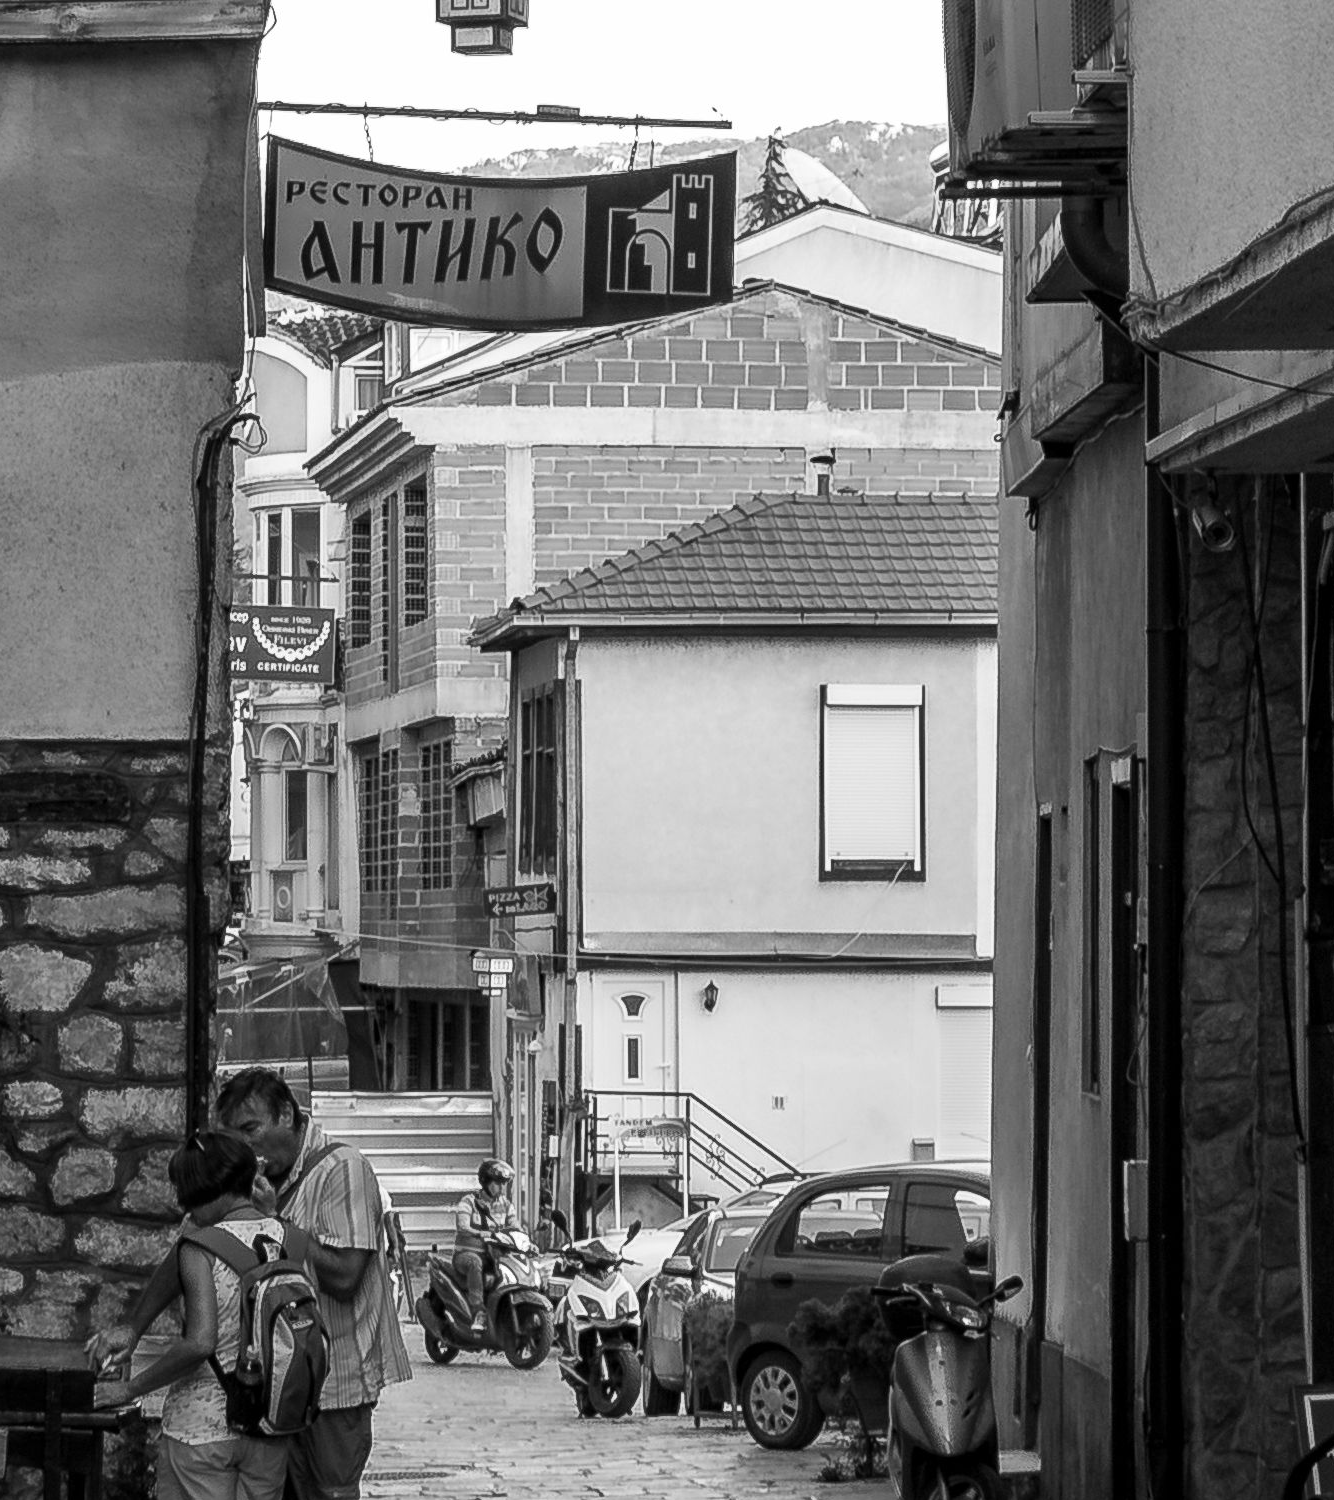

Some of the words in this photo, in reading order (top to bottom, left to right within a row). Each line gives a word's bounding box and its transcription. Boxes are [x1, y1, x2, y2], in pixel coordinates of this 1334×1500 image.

[285, 179, 473, 213] РЕСТОРАН
[299, 205, 564, 286] АНТИКО
[257, 661, 320, 674] CERTIFICATE
[488, 891, 521, 904] PIZZA
